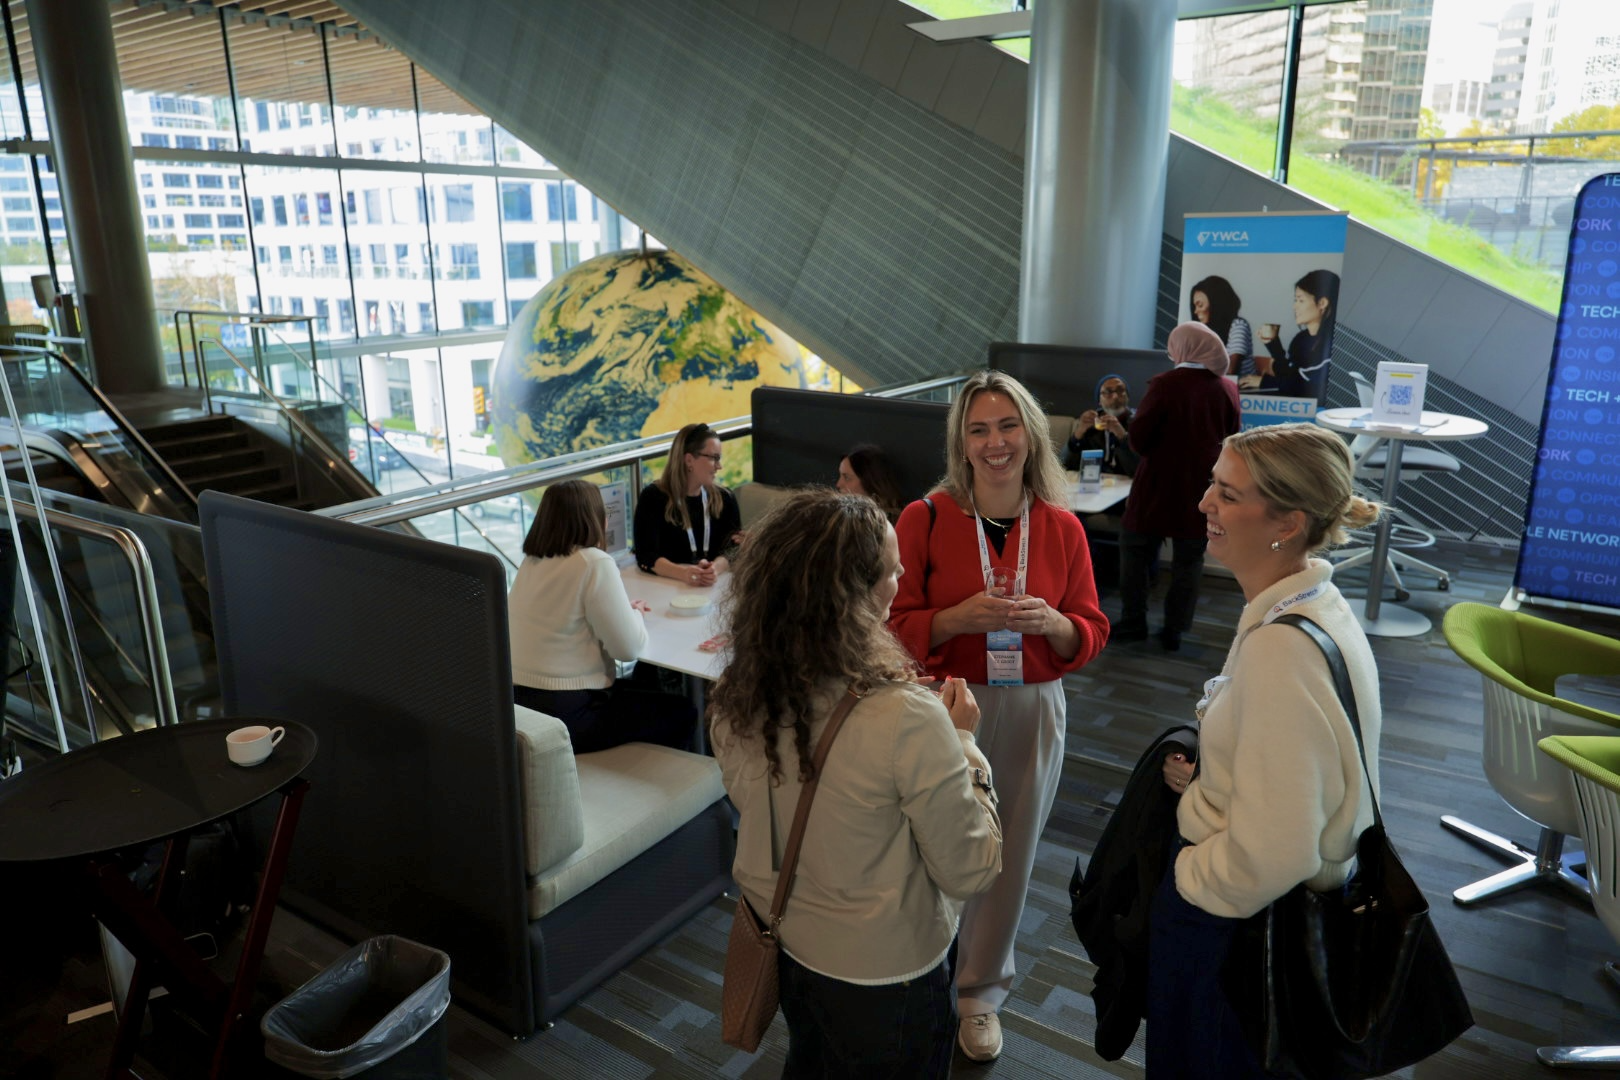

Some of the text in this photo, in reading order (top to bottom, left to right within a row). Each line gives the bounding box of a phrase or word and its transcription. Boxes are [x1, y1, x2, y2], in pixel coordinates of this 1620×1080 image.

[1573, 218, 1612, 231] ORK
[1211, 231, 1249, 242] YWCA
[1591, 240, 1620, 254] CO
[1576, 326, 1620, 340] COM
[1566, 388, 1610, 404] TECH
[1551, 468, 1620, 487] COMMU
[1587, 512, 1620, 528] LEA
[1547, 527, 1620, 549] NETWOR
[1574, 570, 1618, 587] TECH
